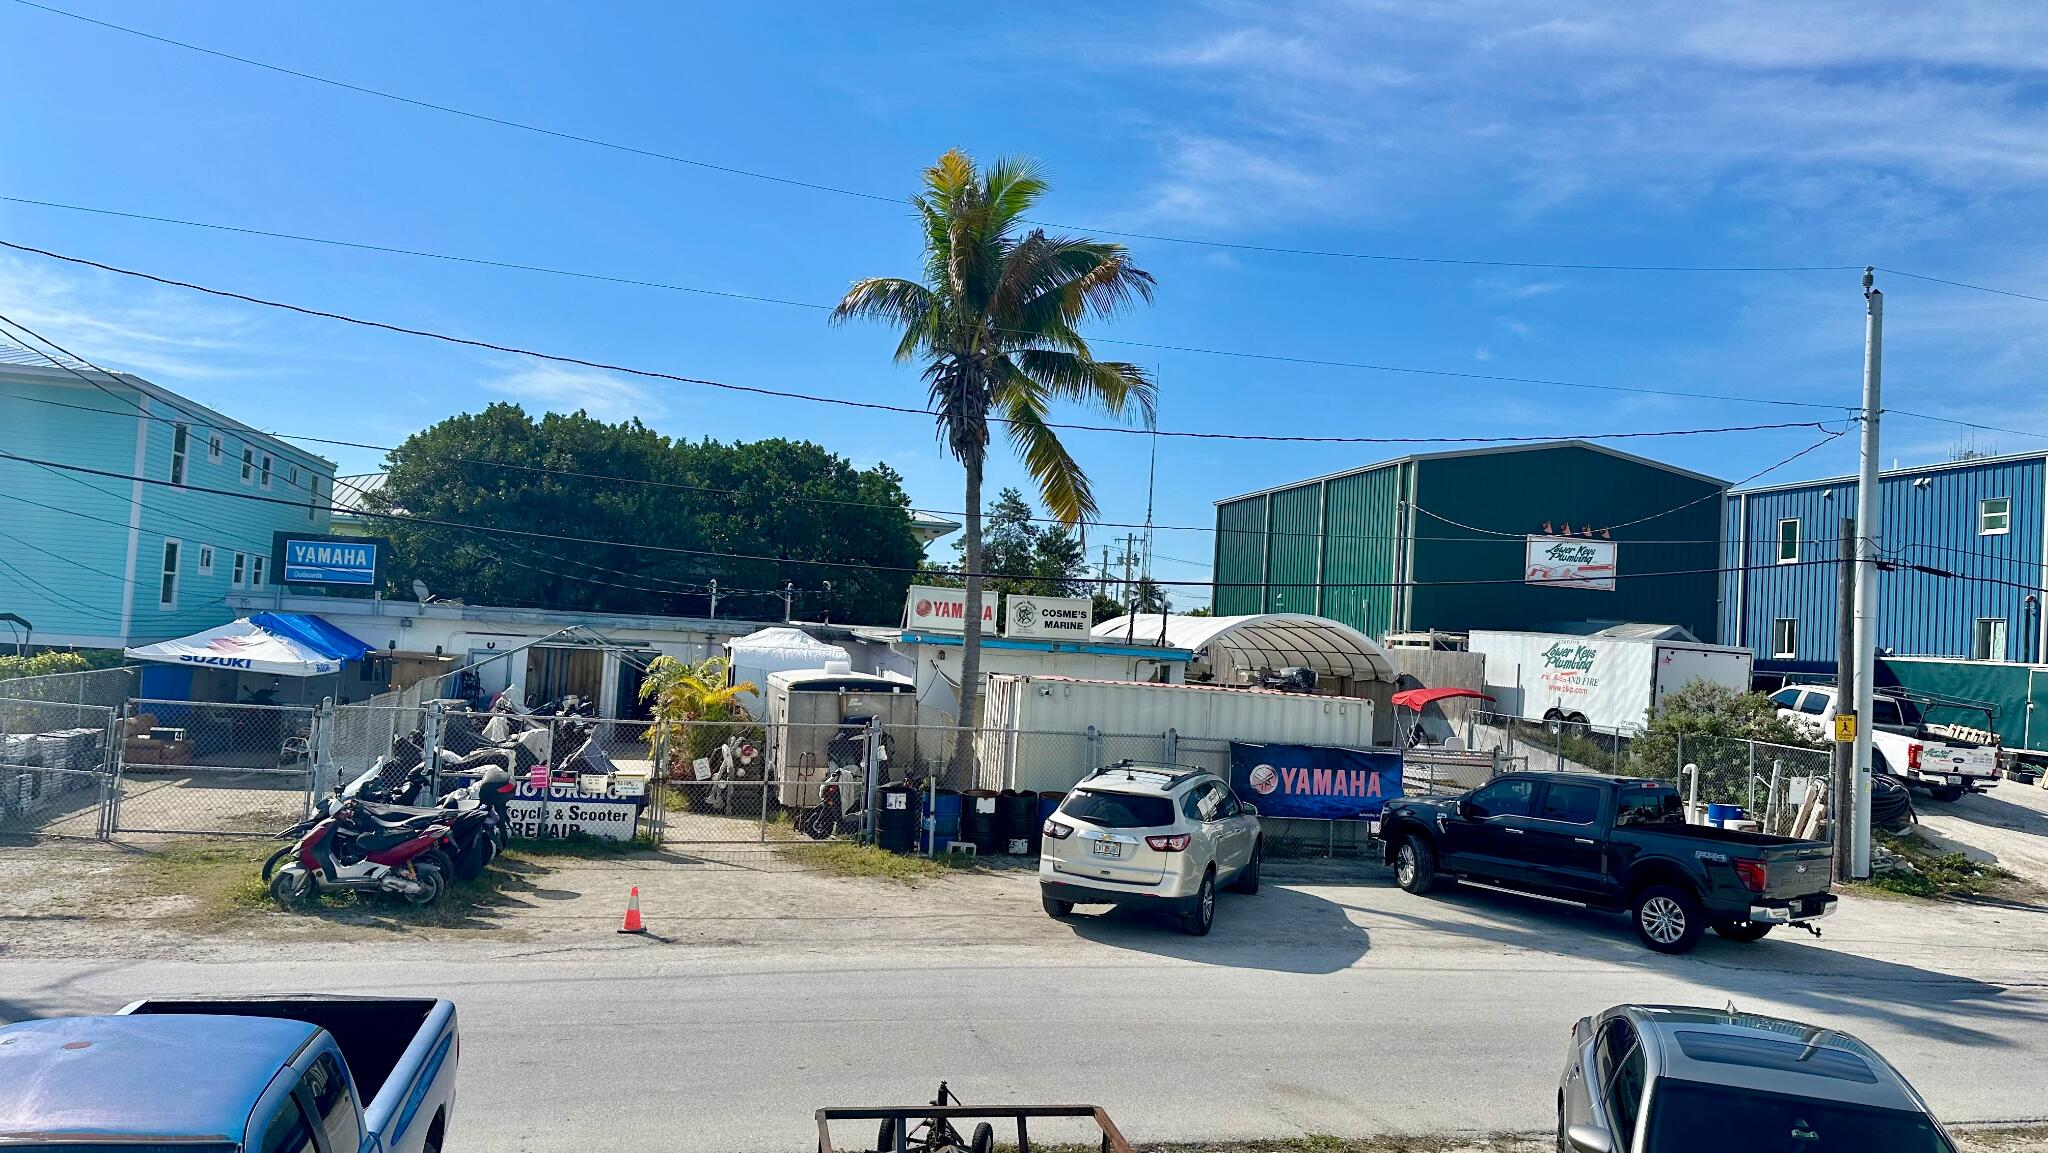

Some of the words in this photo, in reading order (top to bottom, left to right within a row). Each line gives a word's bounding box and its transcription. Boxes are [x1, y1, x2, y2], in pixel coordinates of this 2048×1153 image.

[295, 546, 367, 566] YAMAHA
[1545, 543, 1575, 554] Lower
[1577, 545, 1596, 556] Keys
[1548, 552, 1594, 564] Plumbing
[293, 571, 323, 579] Outboards
[933, 601, 993, 621] YAMA
[1041, 608, 1087, 619] COSME'S
[1044, 621, 1083, 630] MARINE
[1541, 641, 1574, 657] Lower
[1575, 645, 1597, 660] Keys
[179, 655, 252, 669] SUZUKI
[1544, 655, 1593, 673] Plumbing
[1582, 677, 1600, 687] FIRE
[175, 732, 182, 741] 4
[1281, 767, 1382, 797] YAMAHA
[554, 808, 563, 820] &
[568, 805, 628, 822] Scooter
